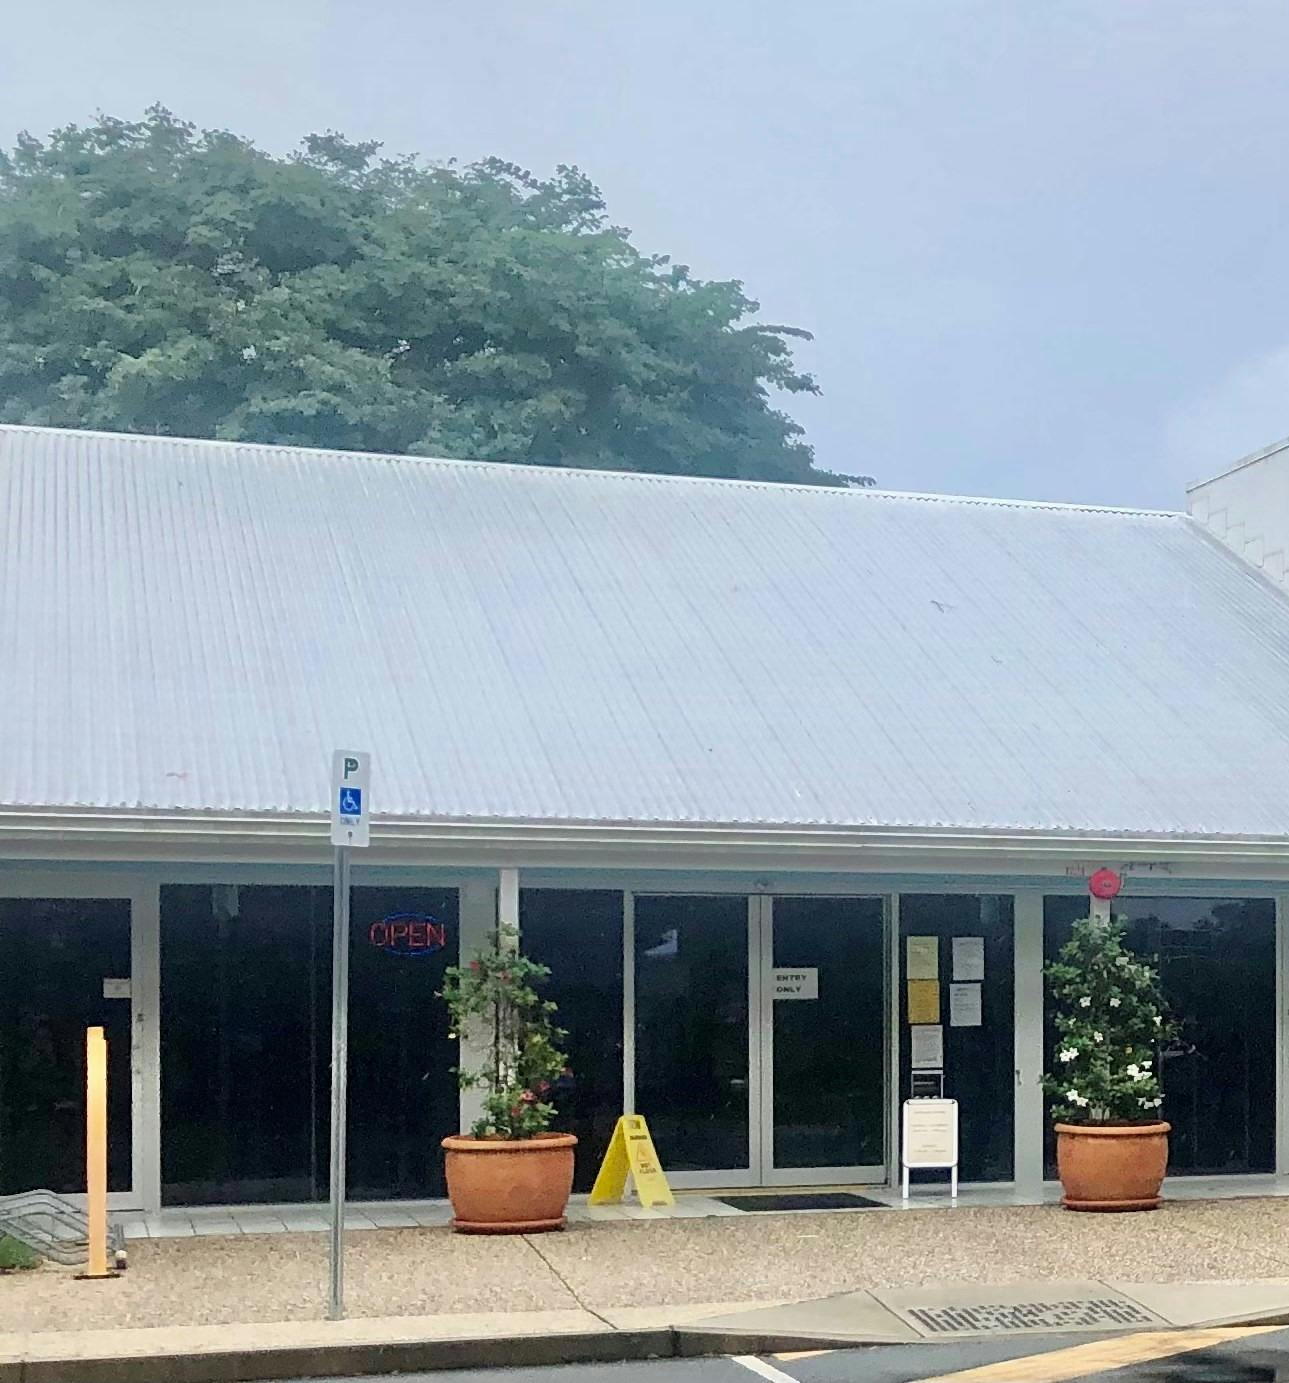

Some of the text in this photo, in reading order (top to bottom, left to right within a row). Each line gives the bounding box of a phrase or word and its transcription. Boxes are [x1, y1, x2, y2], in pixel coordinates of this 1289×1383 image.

[343, 757, 359, 780] P
[369, 922, 446, 947] OPEN
[776, 974, 807, 982] ENTRY
